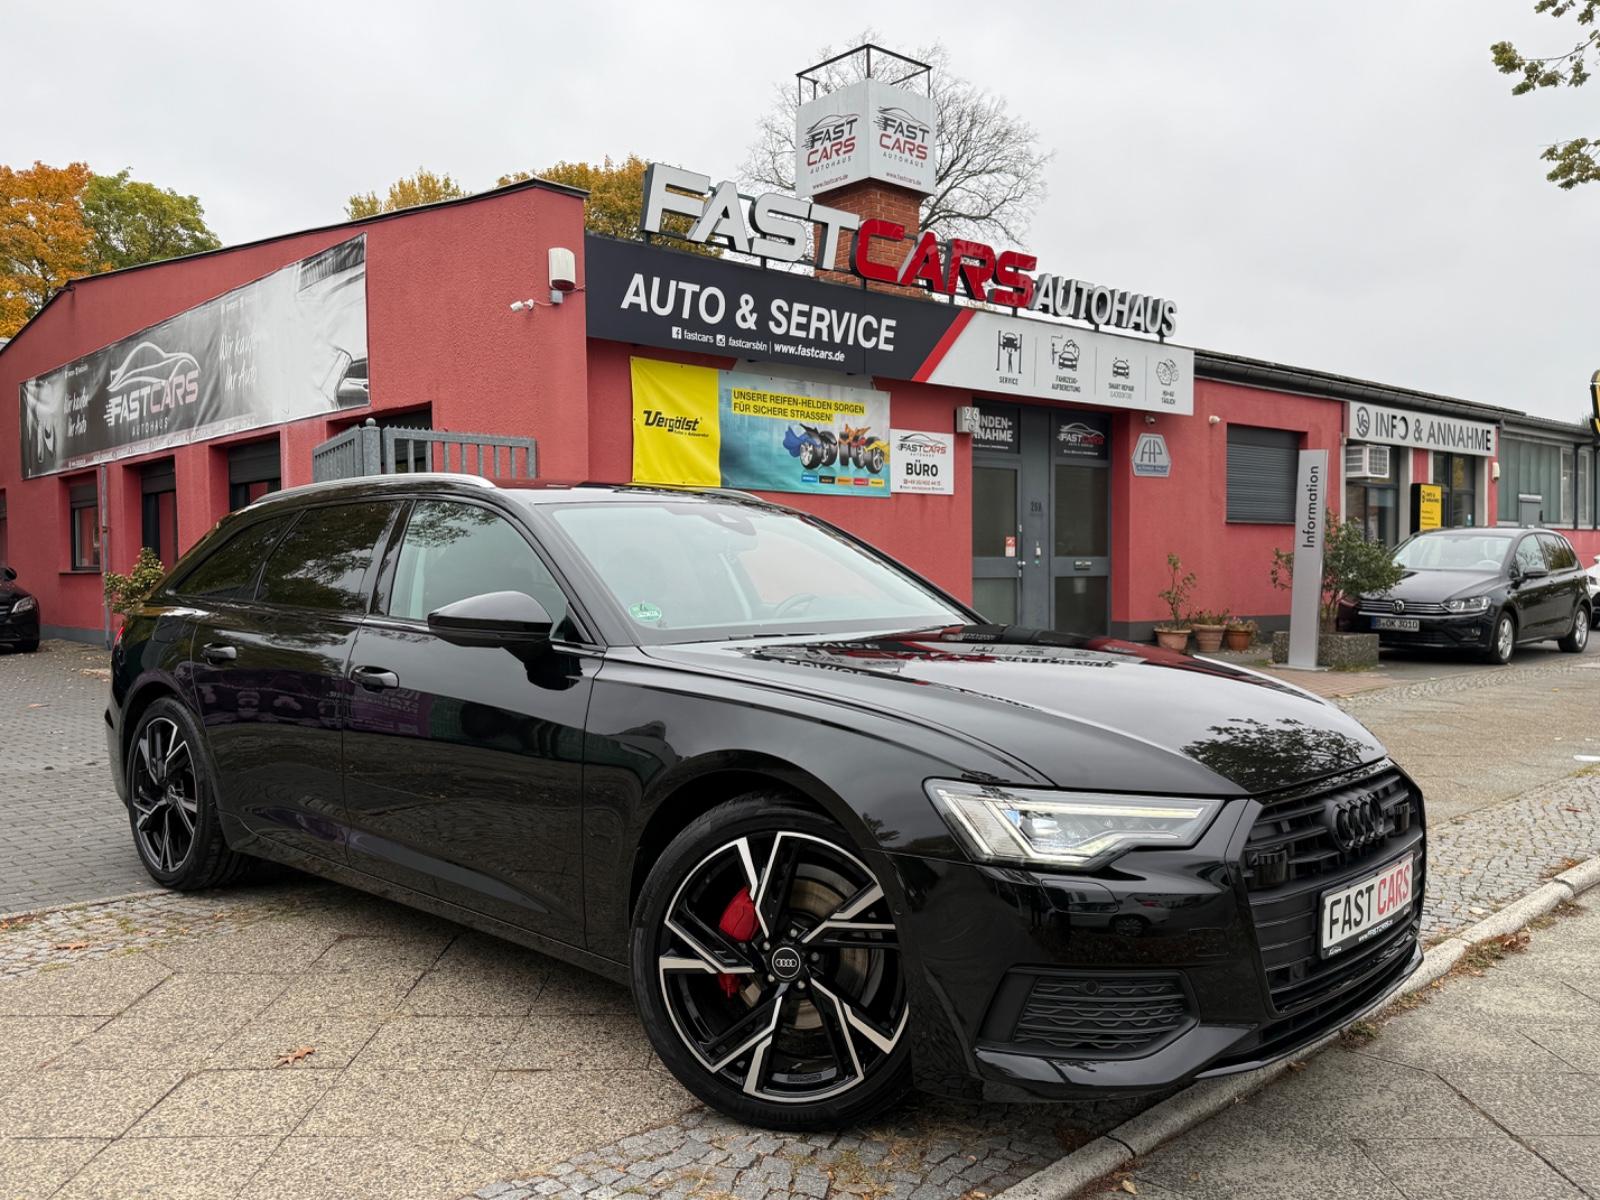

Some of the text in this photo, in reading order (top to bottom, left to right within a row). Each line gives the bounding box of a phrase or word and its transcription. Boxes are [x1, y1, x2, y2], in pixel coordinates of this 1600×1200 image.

[809, 118, 858, 150] FAST
[881, 116, 930, 144] FAST
[807, 136, 856, 167] CARS
[879, 133, 928, 160] CARS
[810, 156, 852, 175] AUTOHAUS
[883, 152, 924, 169] AUTOHAUS
[812, 174, 848, 190] www.fastcars.de
[886, 172, 922, 185] www.fastcars.de
[620, 273, 897, 352] AUTO & SERVICE
[1031, 273, 1177, 338] AUTOHAUS
[683, 330, 714, 344] fastcars
[774, 343, 845, 362] www.fastcars.de
[999, 376, 1019, 386] SERVICE
[108, 370, 199, 427] FASTCARS
[733, 390, 865, 415] UNSERE REIFEN-HELDEN SORGEN
[733, 401, 833, 422] FÜR SICHERE STRASSEN!
[132, 418, 168, 437] AUTOHAUS
[643, 410, 699, 432] Vergölst
[1413, 418, 1423, 442] &
[1427, 421, 1491, 451] ANNAHME
[900, 443, 947, 455] FASTCARS
[906, 459, 939, 477] BÜRO
[1302, 465, 1320, 549] Information
[1329, 884, 1375, 940] FAST
[1377, 864, 1411, 916] CARS
